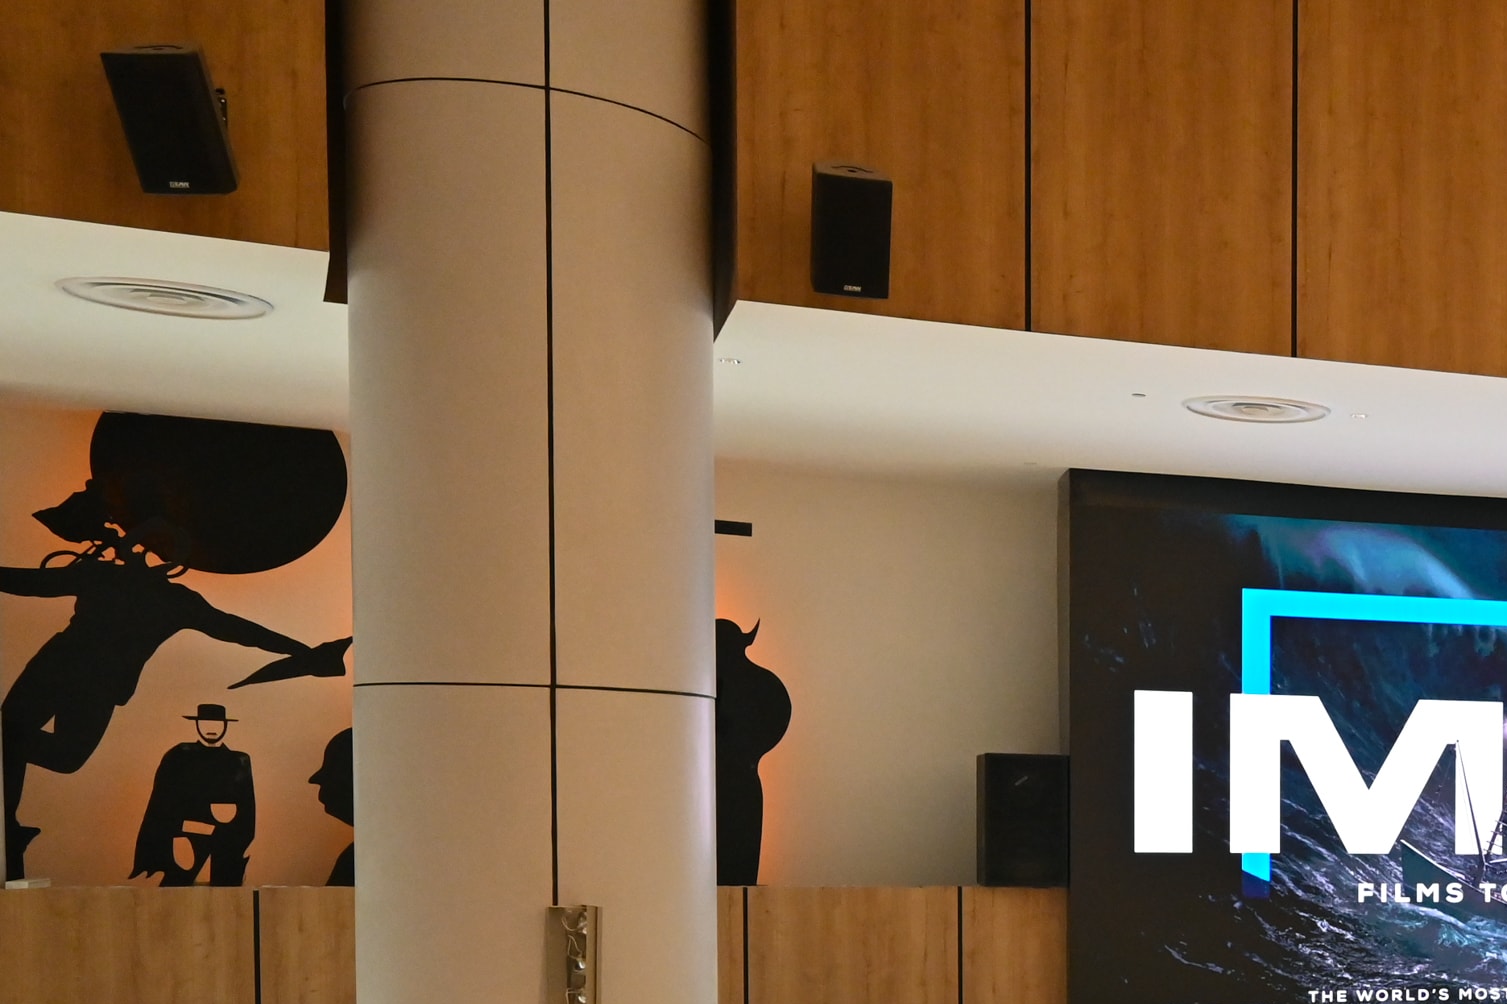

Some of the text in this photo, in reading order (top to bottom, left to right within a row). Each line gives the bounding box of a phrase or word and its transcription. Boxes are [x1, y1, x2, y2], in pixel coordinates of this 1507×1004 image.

[1357, 882, 1464, 904] FILMS
[1308, 988, 1348, 1003] THE
[1355, 987, 1450, 1002] WORLD'S
